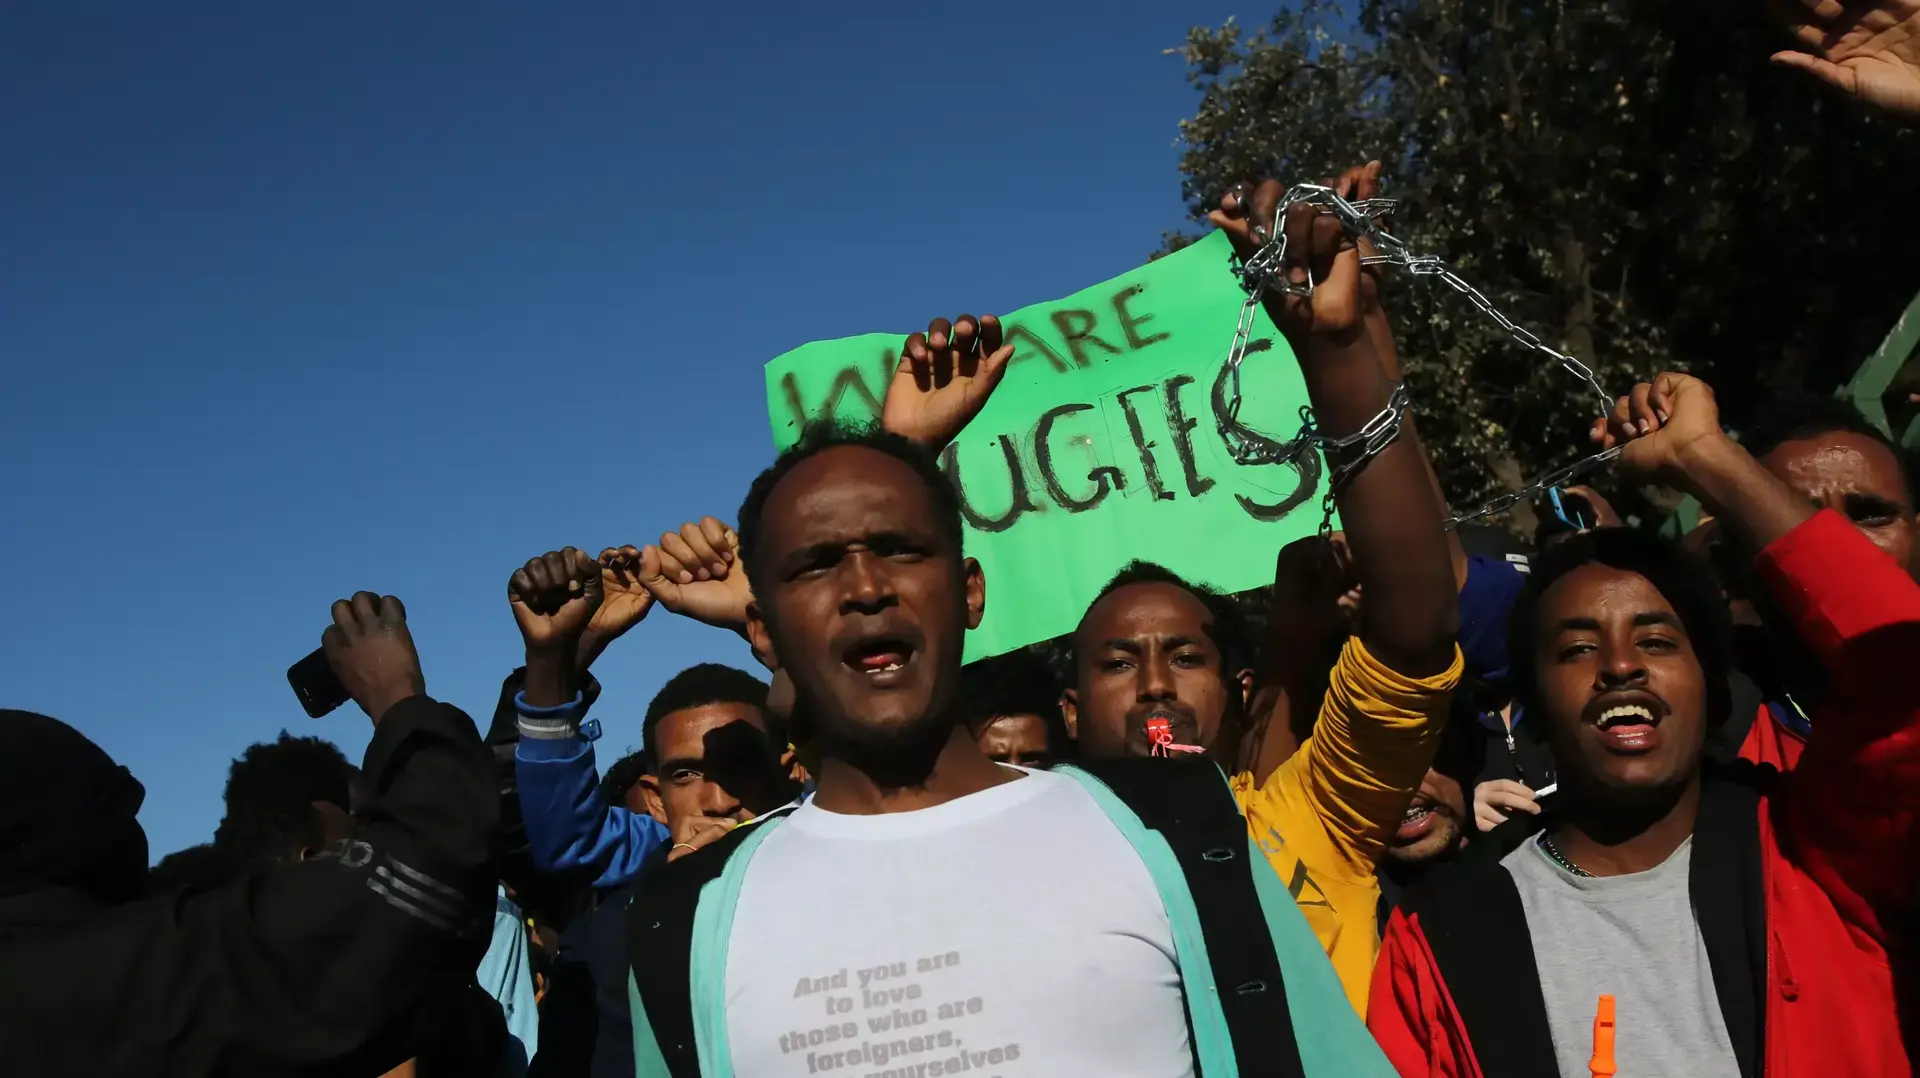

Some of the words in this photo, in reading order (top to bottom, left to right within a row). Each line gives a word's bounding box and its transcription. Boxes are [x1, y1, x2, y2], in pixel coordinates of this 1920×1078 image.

[1003, 282, 1171, 373] ARE
[938, 337, 1322, 533] UGEES
[793, 968, 848, 999] And
[857, 961, 907, 988] you
[916, 950, 960, 973] are
[825, 996, 853, 1015] to
[862, 984, 922, 1009] love
[779, 1021, 858, 1054] those
[867, 1008, 927, 1034] who
[937, 997, 984, 1020] are
[806, 1030, 962, 1074] foreigners,
